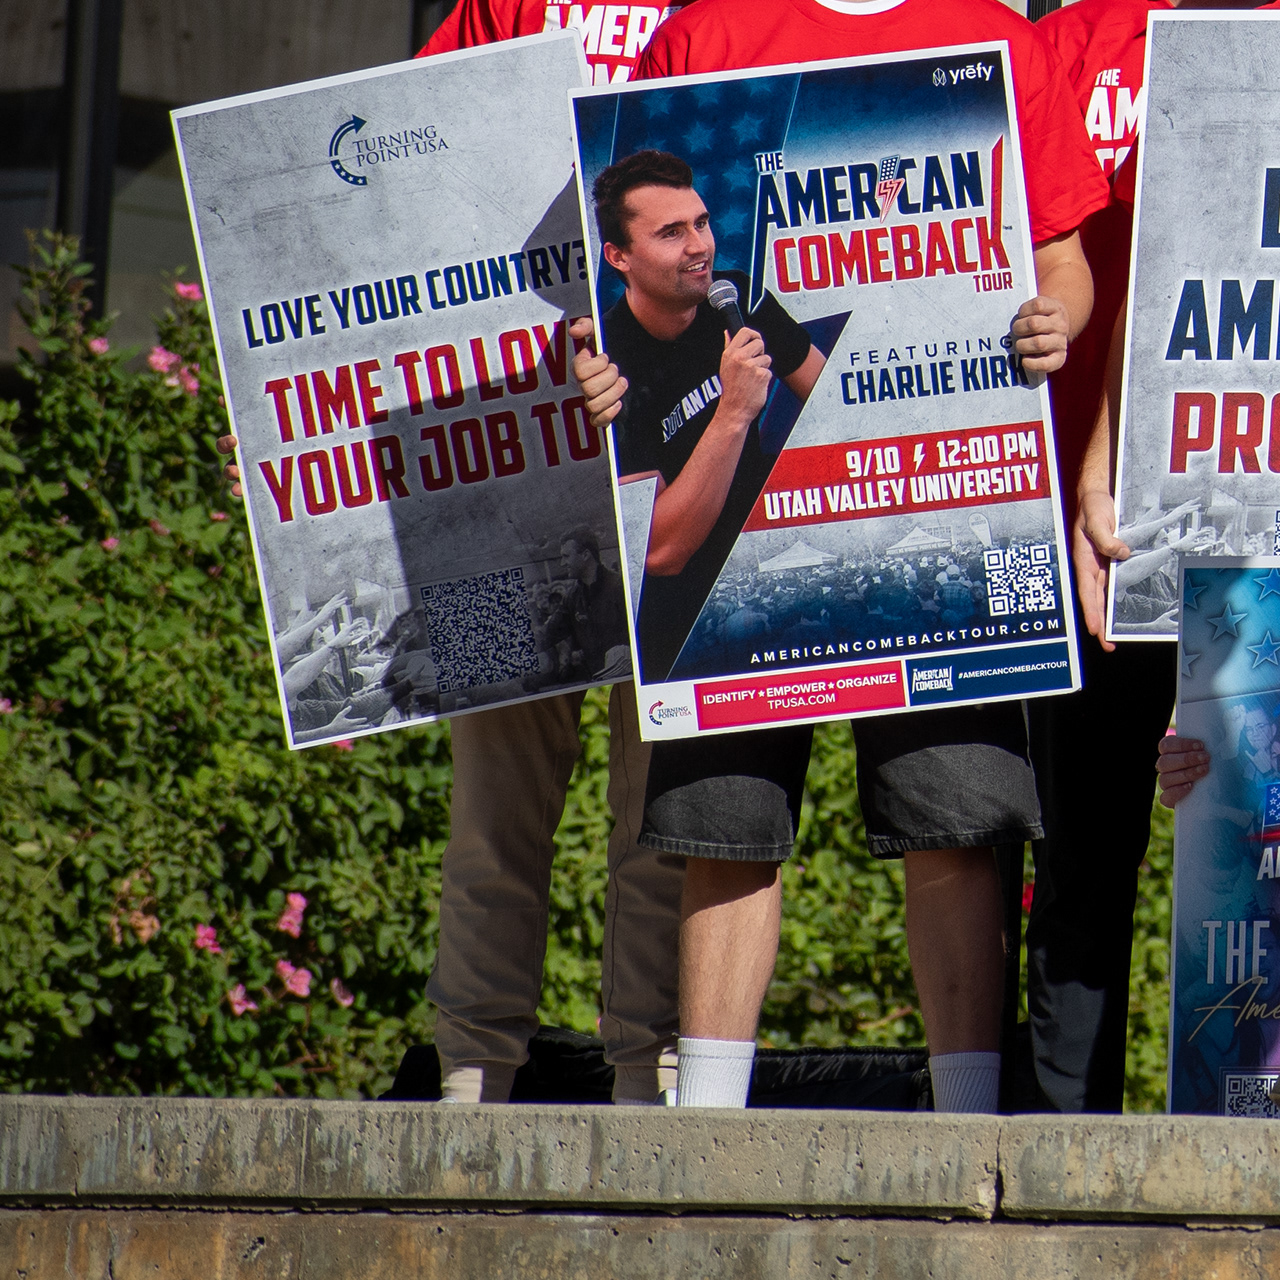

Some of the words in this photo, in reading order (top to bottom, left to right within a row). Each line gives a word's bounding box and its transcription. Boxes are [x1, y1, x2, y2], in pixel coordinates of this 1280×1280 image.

[1094, 69, 1120, 86] THE
[352, 125, 438, 153] TURNING
[356, 144, 412, 168] POINT
[412, 137, 449, 158] USA
[755, 152, 784, 173] THE
[773, 192, 1011, 294] COMEBACK
[242, 297, 326, 349] LOVE
[328, 274, 422, 329] YOUR
[425, 240, 588, 310] COUNTRY?
[973, 271, 1013, 293] TOUR
[850, 335, 1014, 366] FEATURING
[264, 358, 388, 443] TIME
[394, 343, 466, 415] TO
[840, 361, 955, 406] CHARLIE
[960, 353, 1029, 393] KIRK
[681, 389, 705, 420] AN
[258, 435, 411, 523] YOUR
[417, 407, 527, 493] JOB
[846, 446, 901, 479] 9/10
[936, 435, 1000, 469] 12:00
[1005, 431, 1038, 460] PM
[763, 487, 823, 521] UTAH
[824, 477, 905, 516] VALLEY
[910, 463, 1039, 505] UNIVERSITY
[750, 618, 1060, 664] AMERICANCOMEBACKTOUR.COM
[915, 676, 953, 692] COMEBACK
[957, 660, 1068, 680] #AMERICANCOMEBACKTOUR
[703, 690, 756, 705] IDENTIFY
[766, 681, 826, 698] EMPOWER
[836, 673, 897, 689] ORGANIZE
[767, 694, 836, 711] TPUSA.COM
[657, 705, 689, 714] TURNING
[658, 711, 679, 719] POINT
[679, 709, 692, 717] USA
[1202, 920, 1270, 985] THE
